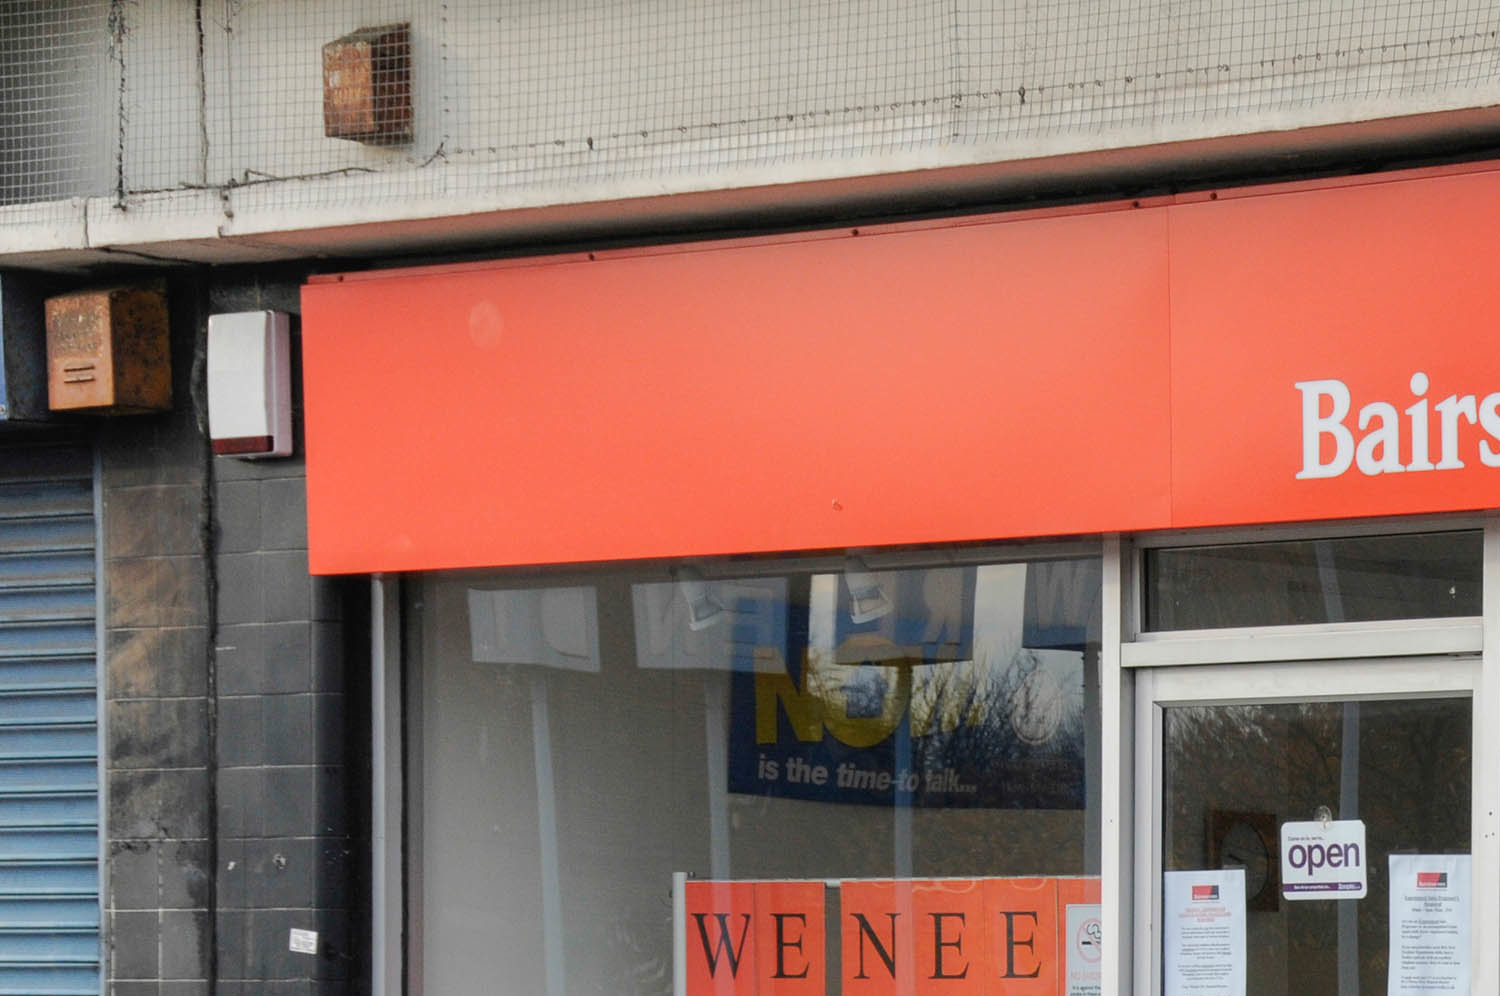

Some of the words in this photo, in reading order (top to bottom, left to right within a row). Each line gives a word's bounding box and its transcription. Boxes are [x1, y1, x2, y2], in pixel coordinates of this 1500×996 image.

[758, 754, 779, 780] is
[785, 758, 828, 785] the
[837, 761, 892, 791] time
[898, 771, 920, 792] to
[1288, 843, 1360, 876] open
[691, 912, 810, 979] WE
[850, 911, 1042, 979] NEE
